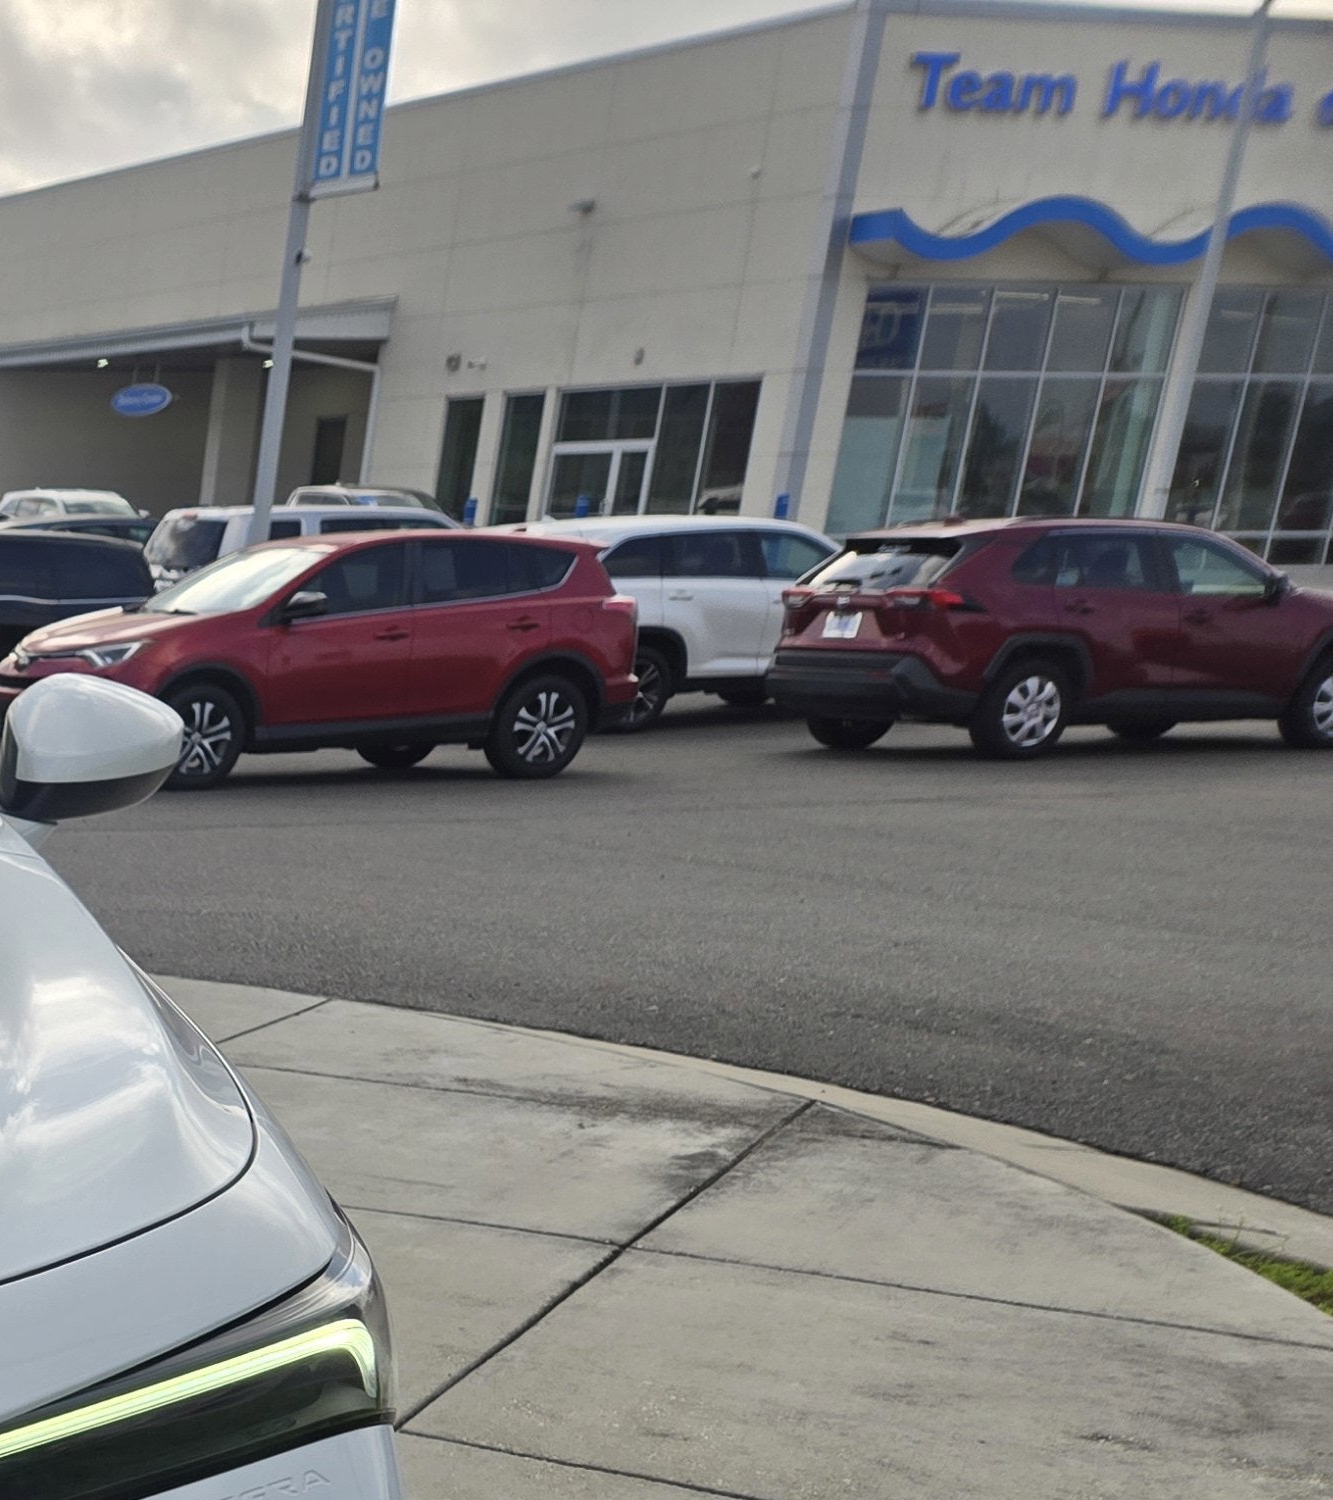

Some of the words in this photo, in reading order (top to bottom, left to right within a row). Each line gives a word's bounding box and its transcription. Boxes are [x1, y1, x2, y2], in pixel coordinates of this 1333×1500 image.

[319, 0, 354, 176] RTIFIED
[354, 47, 384, 171] OWNED
[910, 50, 1077, 115] Team
